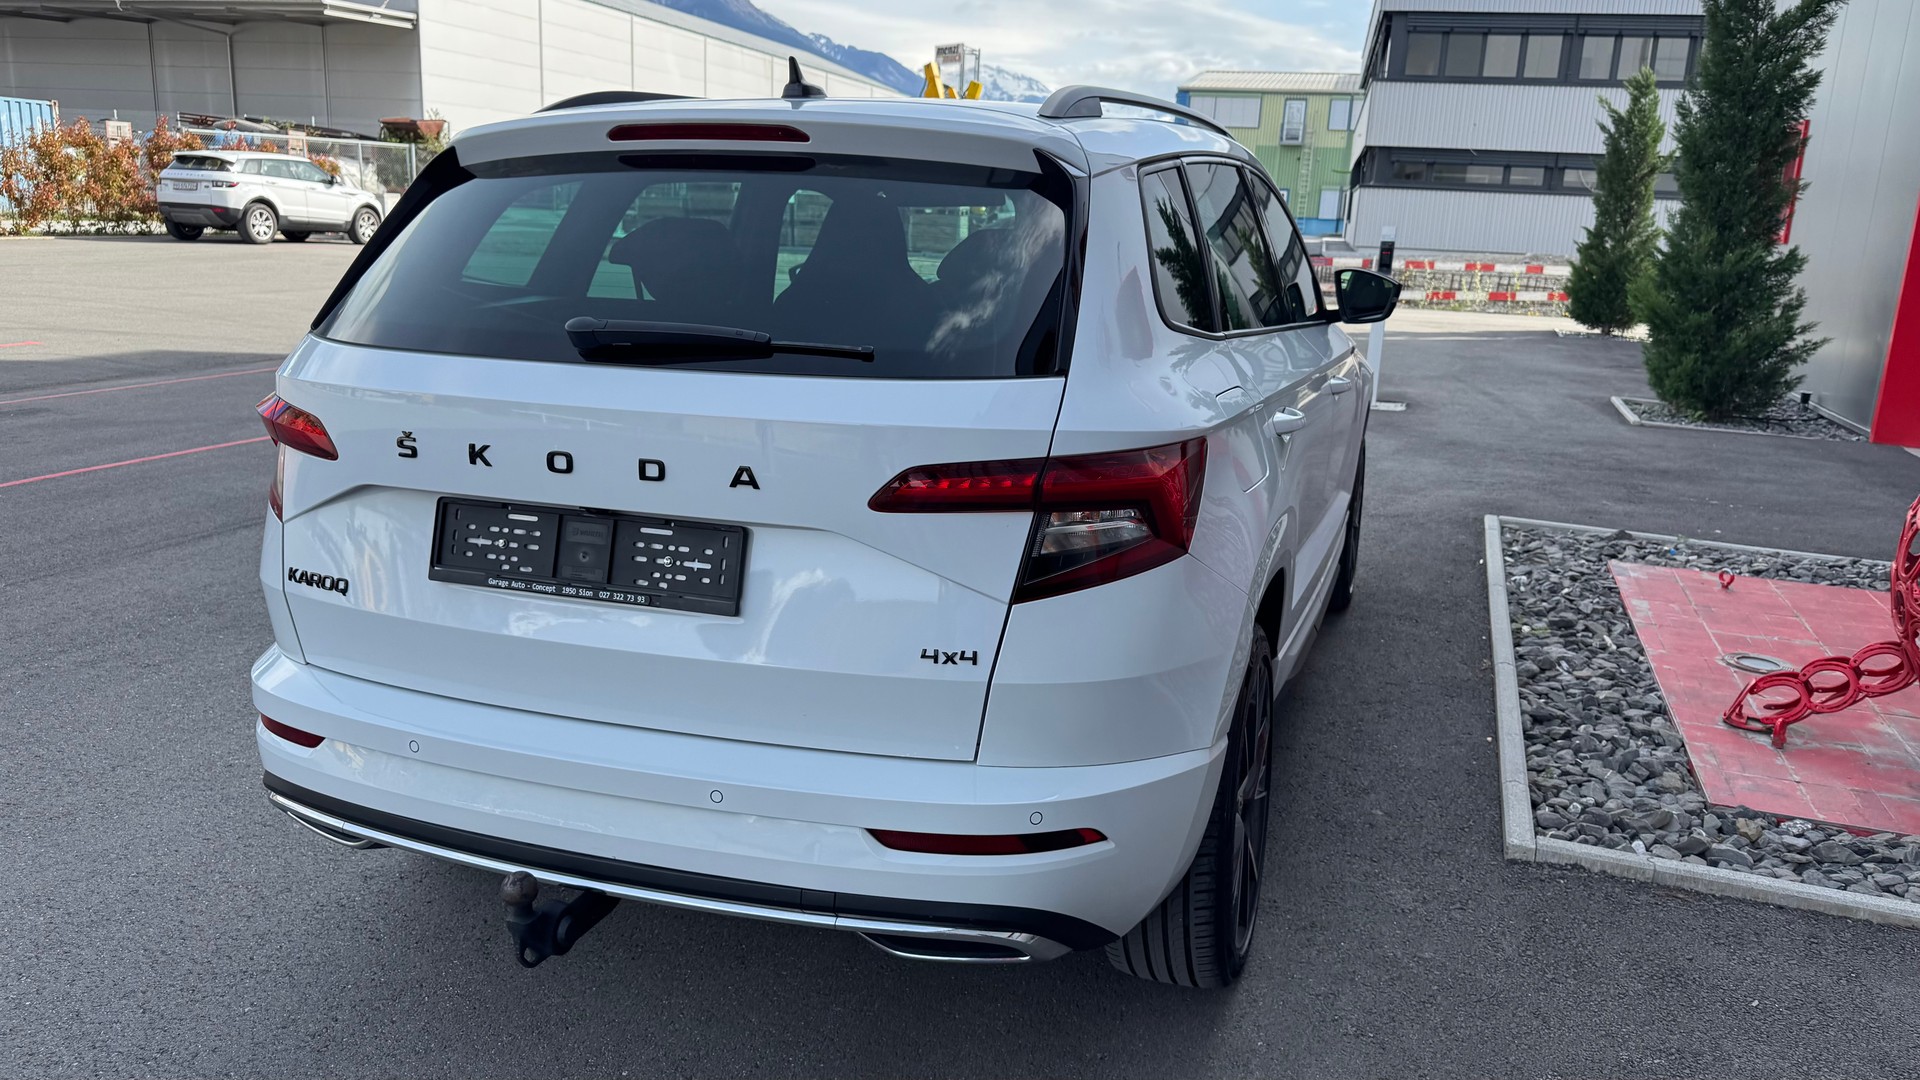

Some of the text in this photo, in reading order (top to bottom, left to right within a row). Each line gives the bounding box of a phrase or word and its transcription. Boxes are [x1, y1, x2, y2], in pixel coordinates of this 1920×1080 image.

[396, 431, 760, 490] ŠKODA
[288, 567, 349, 597] KAROQ
[488, 578, 509, 588] Garage
[532, 583, 556, 593] Concept
[562, 587, 576, 595] 1950
[579, 589, 593, 597] Sion
[599, 591, 610, 599] 027
[613, 593, 624, 601] 322
[920, 649, 977, 665] 4x4
